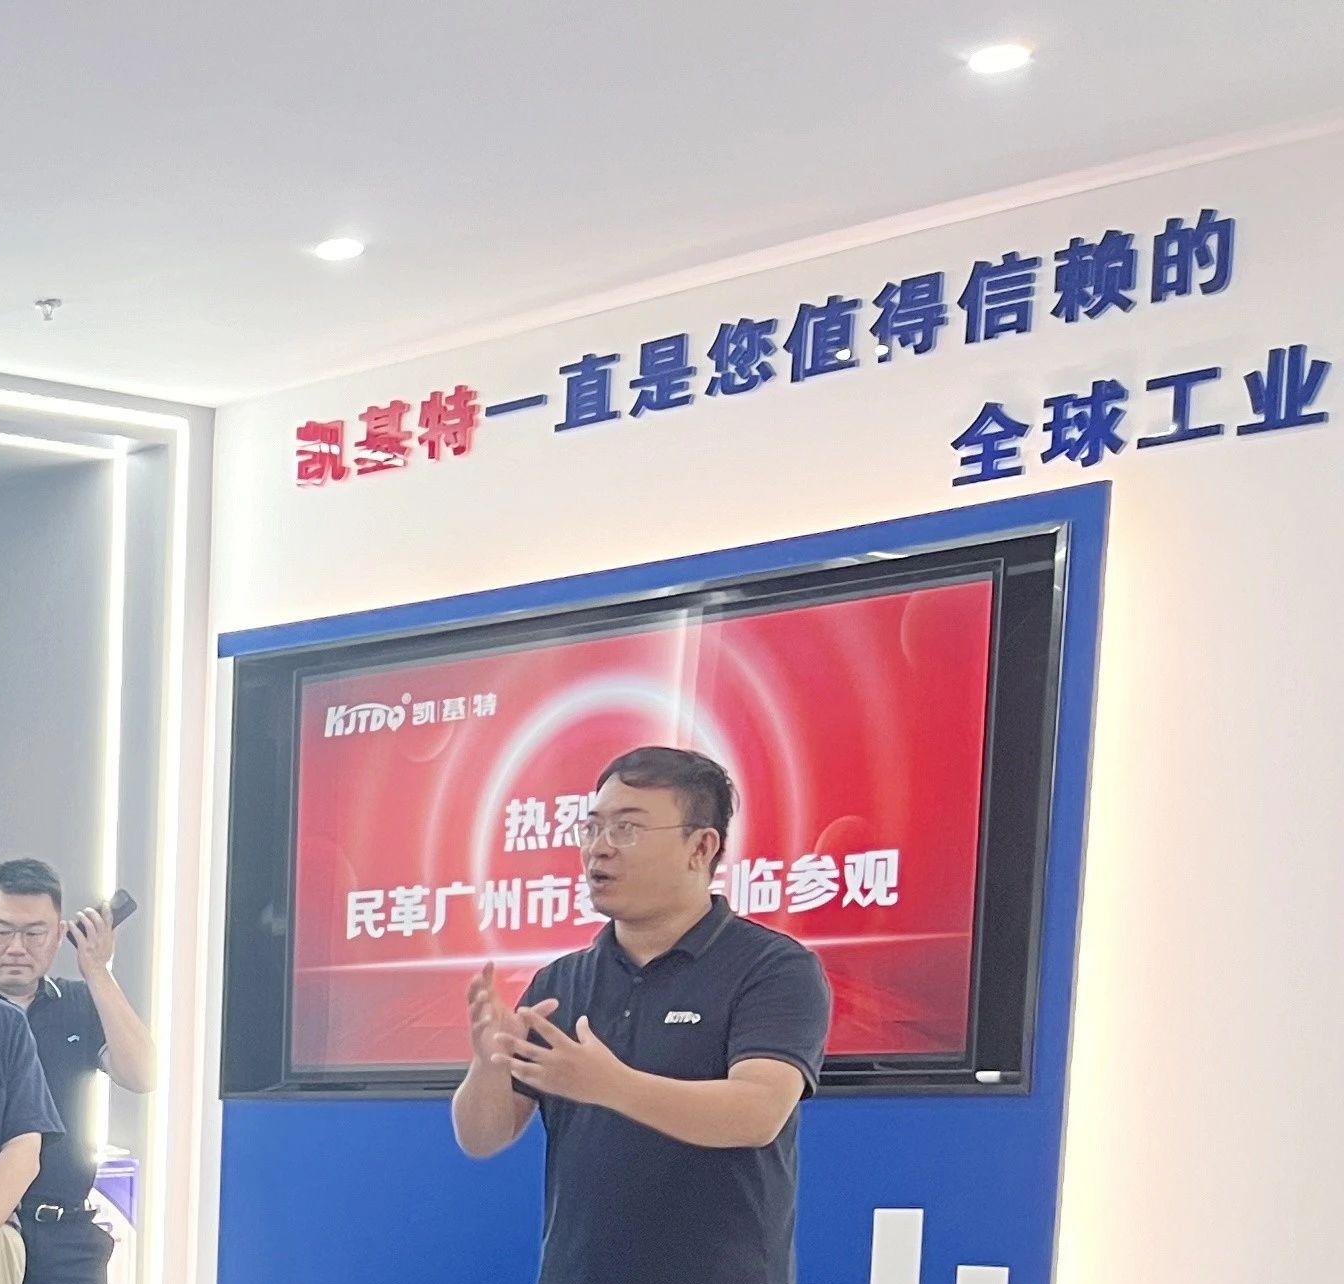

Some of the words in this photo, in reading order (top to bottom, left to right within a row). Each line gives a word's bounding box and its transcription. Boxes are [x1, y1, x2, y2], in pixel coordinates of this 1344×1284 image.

[296, 210, 1235, 487] 凯基特一直是您值得信赖的
[953, 345, 1330, 487] 全球工业
[324, 702, 406, 738] KJTDO
